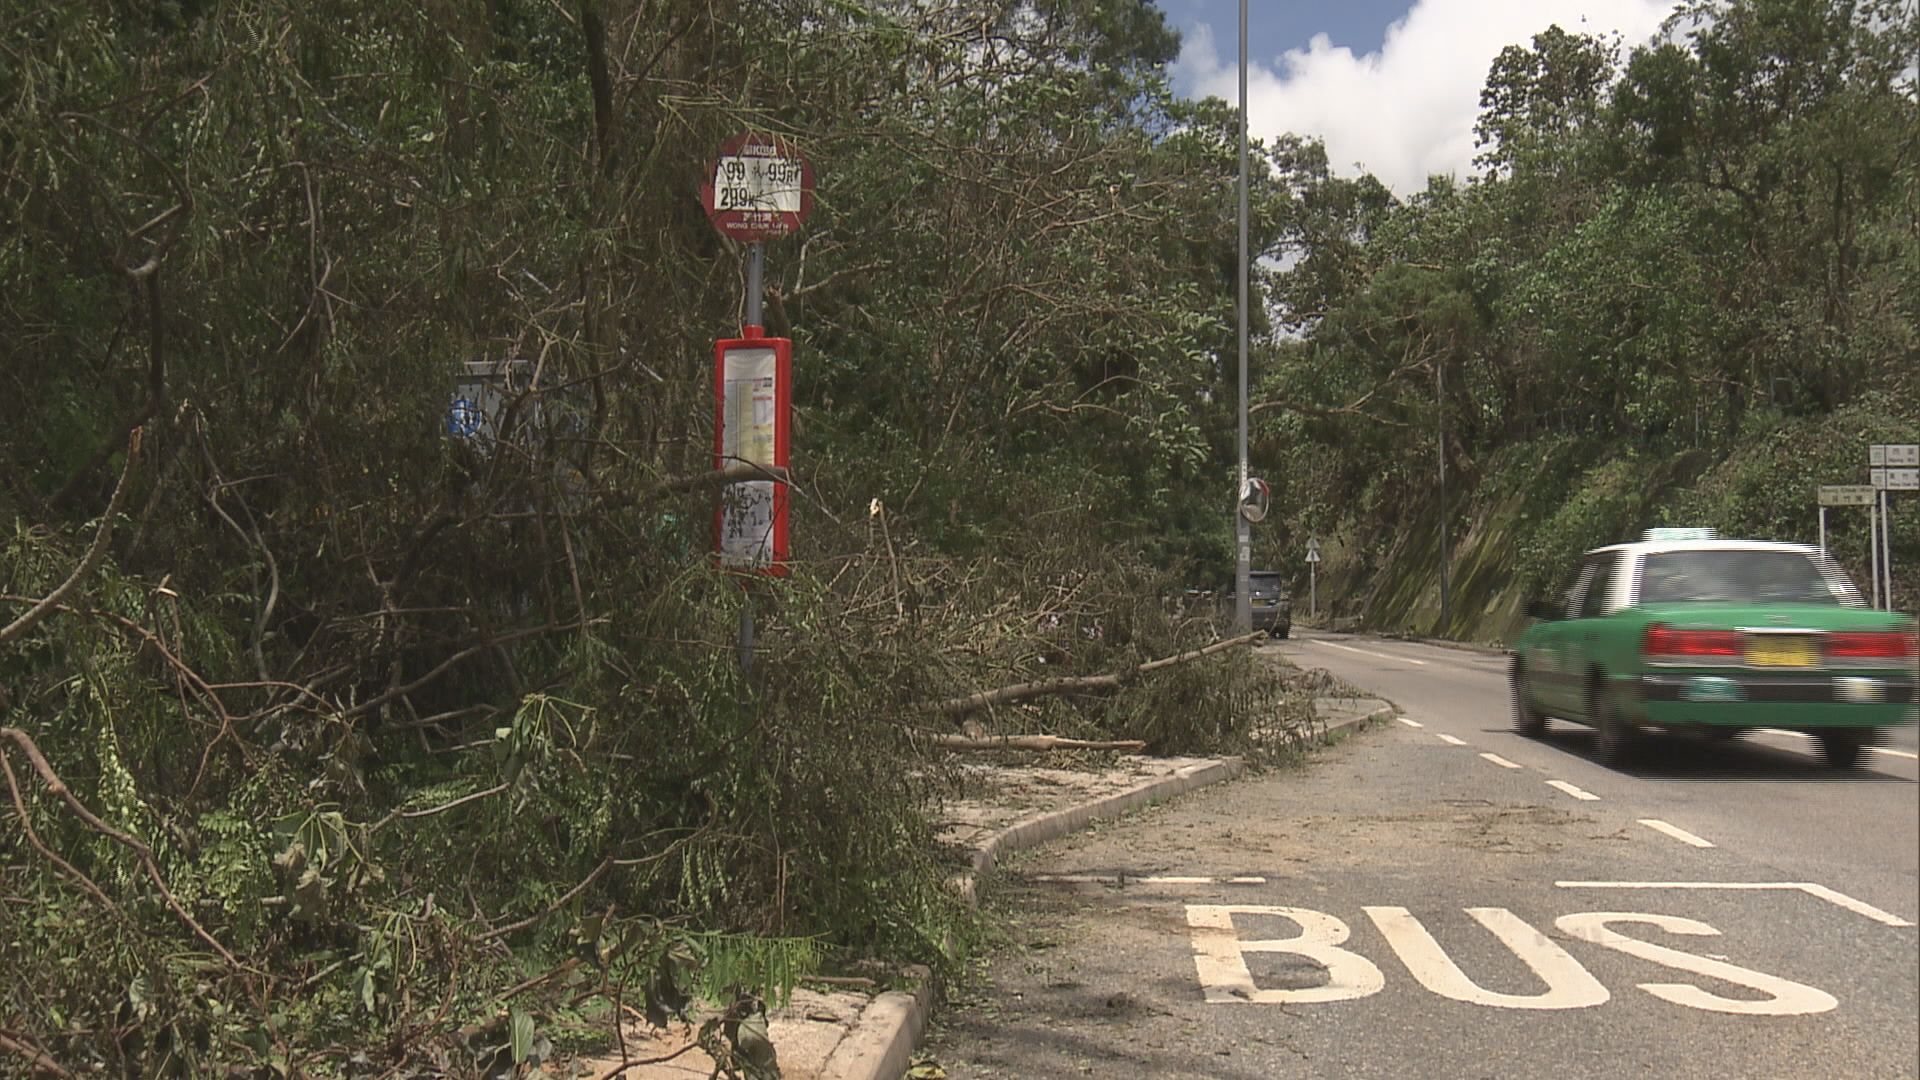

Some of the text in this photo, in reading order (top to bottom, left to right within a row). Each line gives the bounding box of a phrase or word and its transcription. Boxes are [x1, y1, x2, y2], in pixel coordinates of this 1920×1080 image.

[726, 161, 745, 181] 99
[726, 221, 749, 230] WONG
[1184, 904, 1840, 1015] BUS
